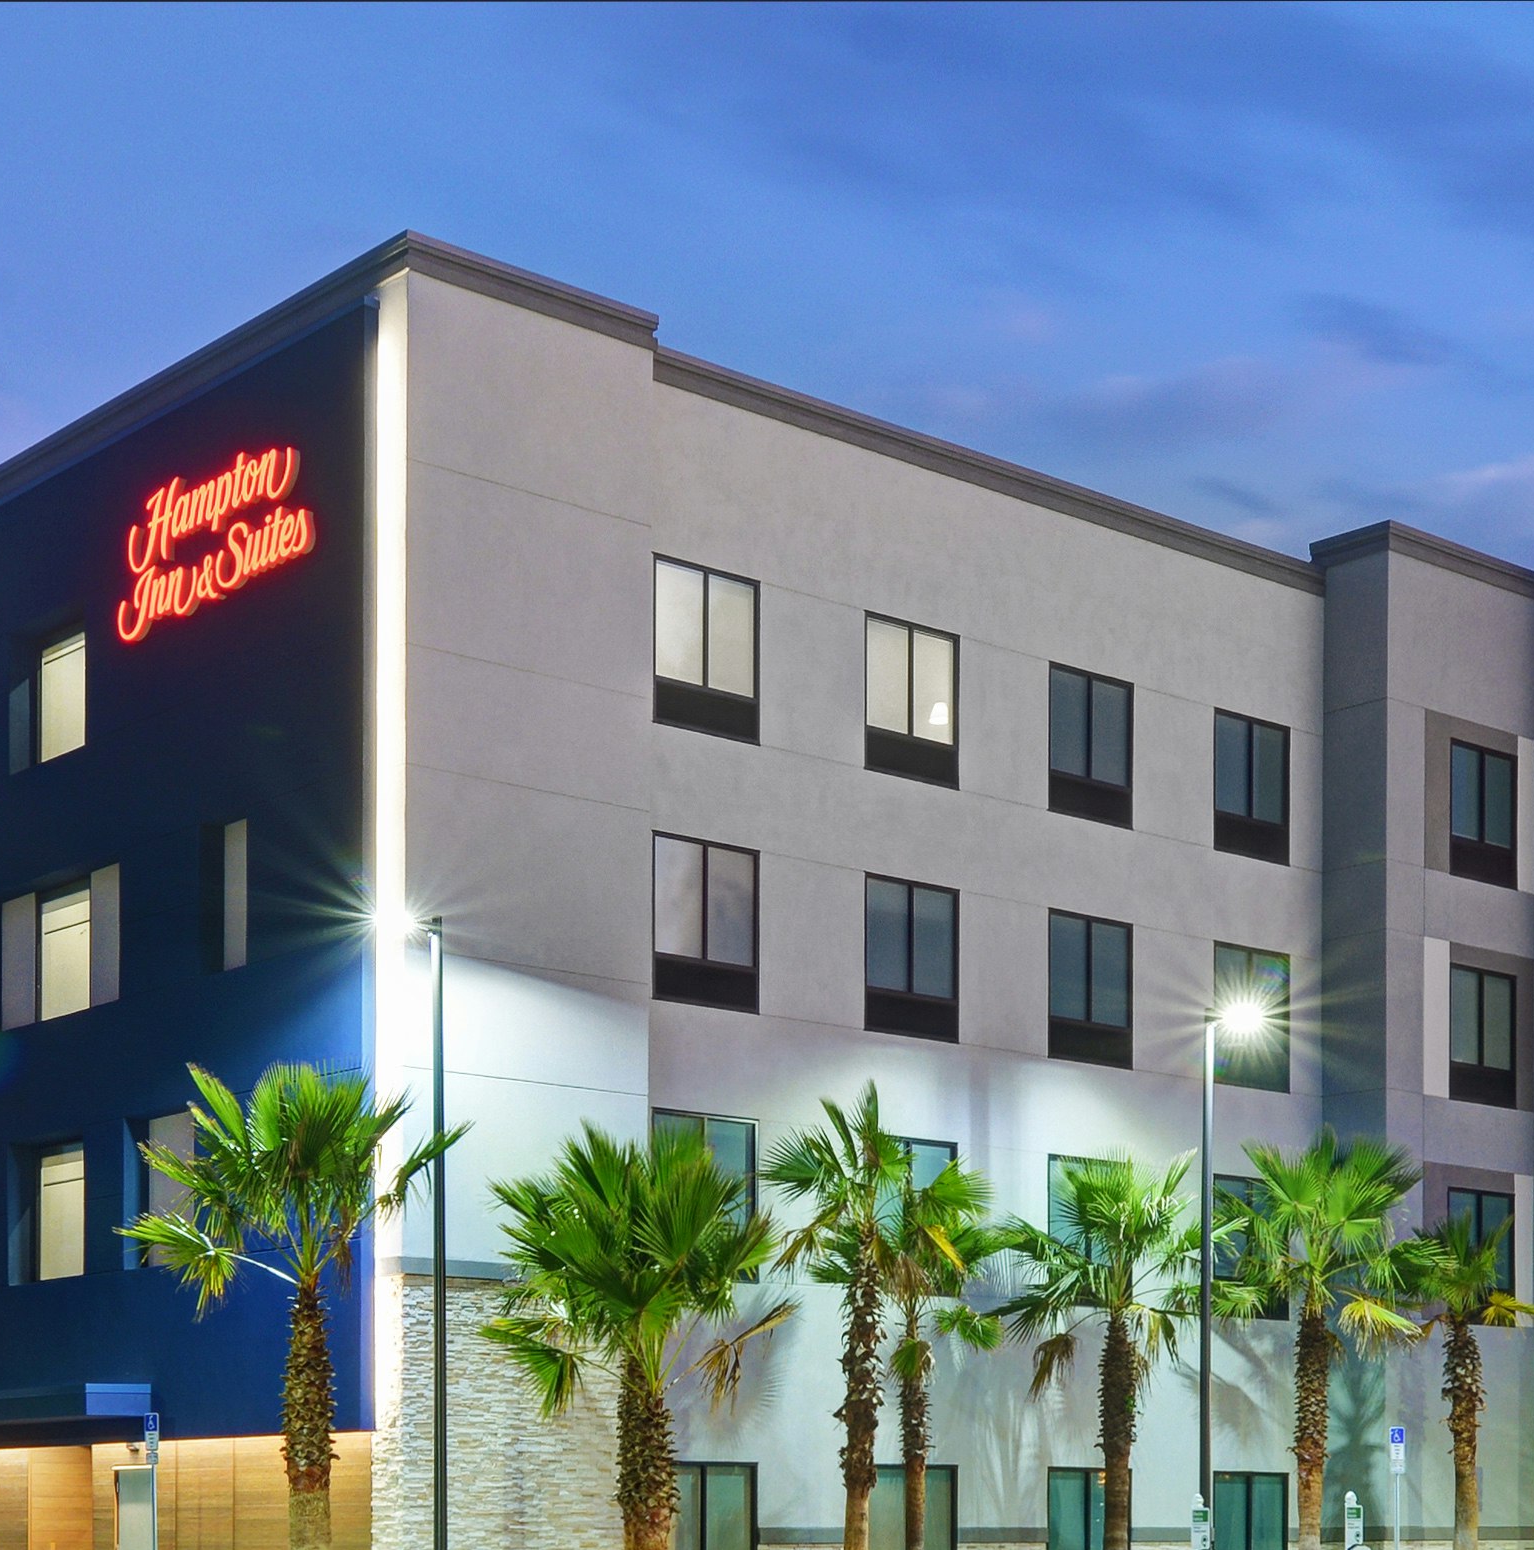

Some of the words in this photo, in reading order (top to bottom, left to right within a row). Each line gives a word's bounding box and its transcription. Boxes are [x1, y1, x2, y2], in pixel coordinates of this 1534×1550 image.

[117, 565, 198, 642] Inn
[196, 554, 224, 600] &
[216, 505, 314, 590] Suites
[127, 446, 299, 574] Hampton
